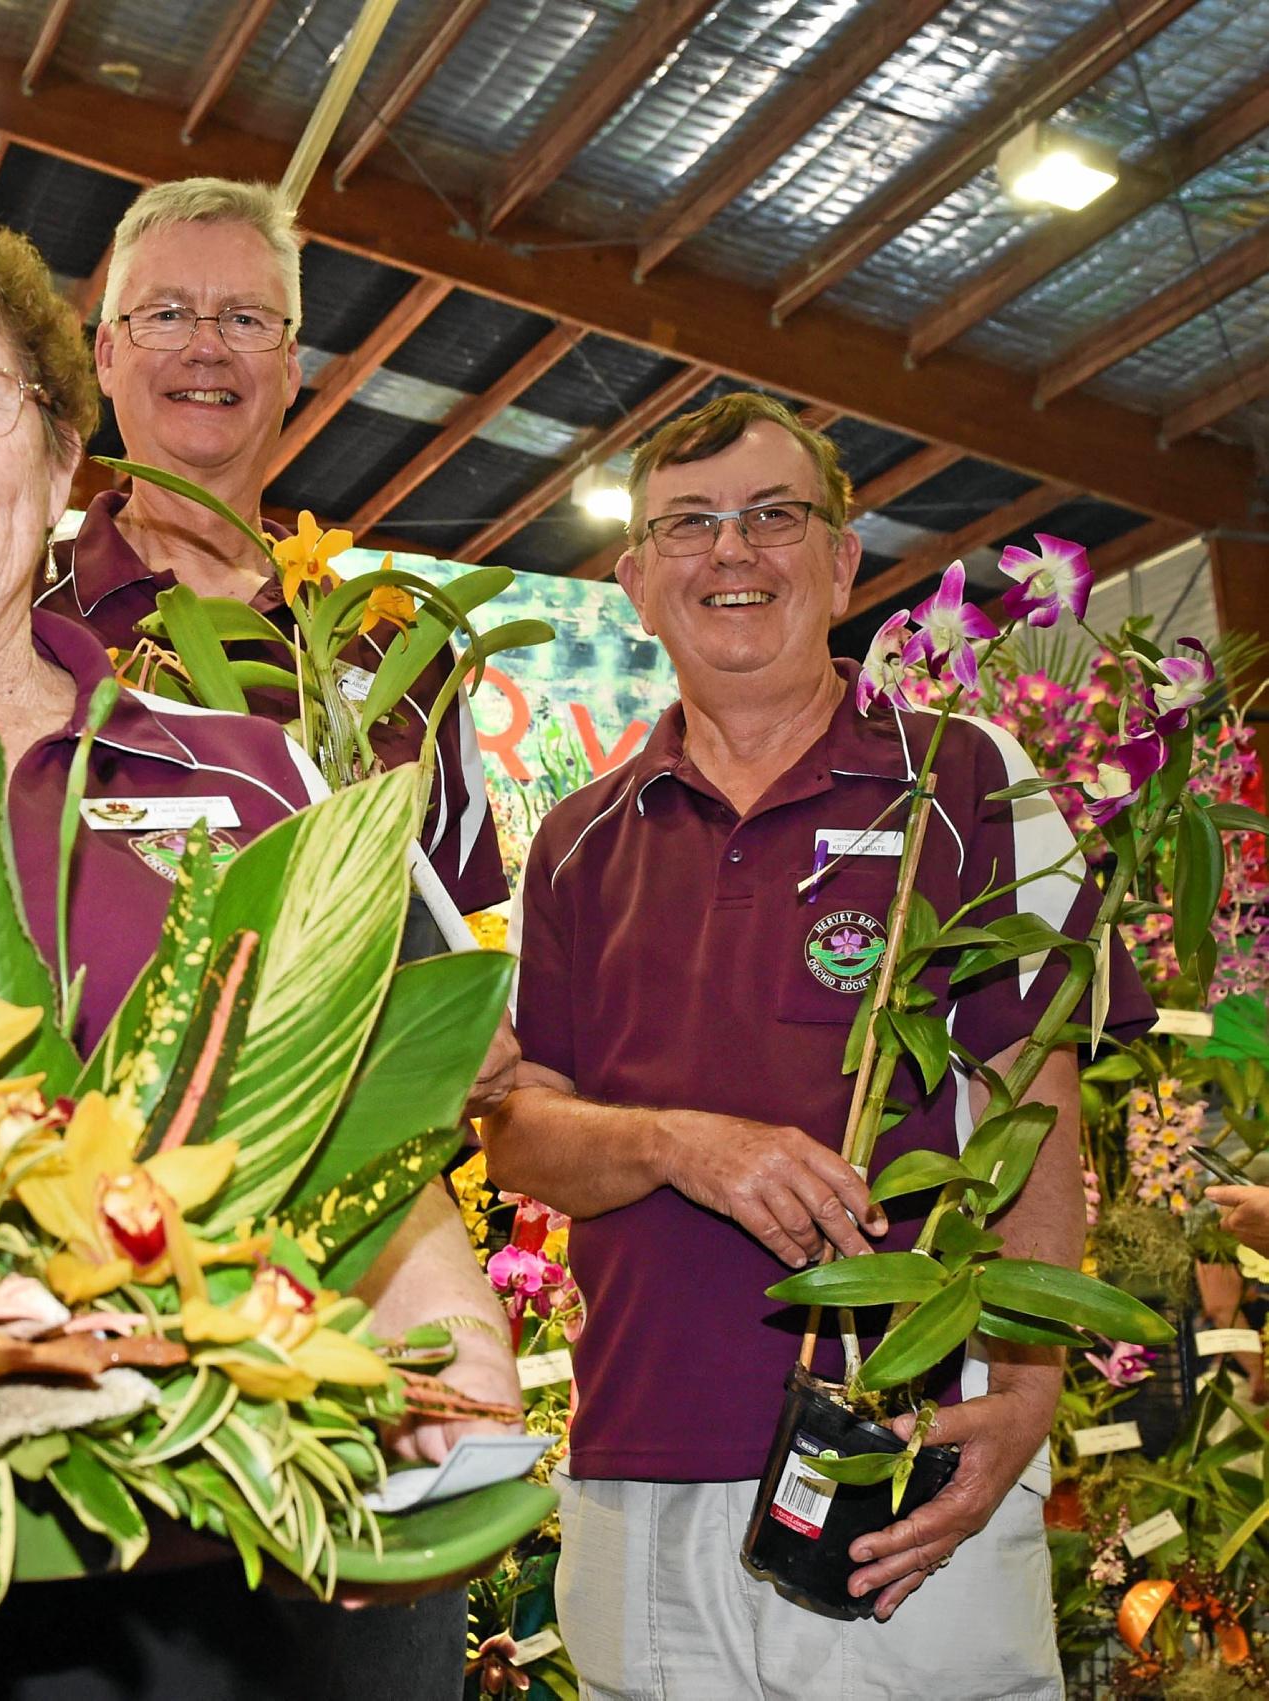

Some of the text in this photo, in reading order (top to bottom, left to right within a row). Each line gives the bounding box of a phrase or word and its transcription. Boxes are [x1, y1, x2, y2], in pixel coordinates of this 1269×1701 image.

[815, 912, 877, 933] HERVEY BAY
[808, 958, 871, 990] ORCHID SOCIE
